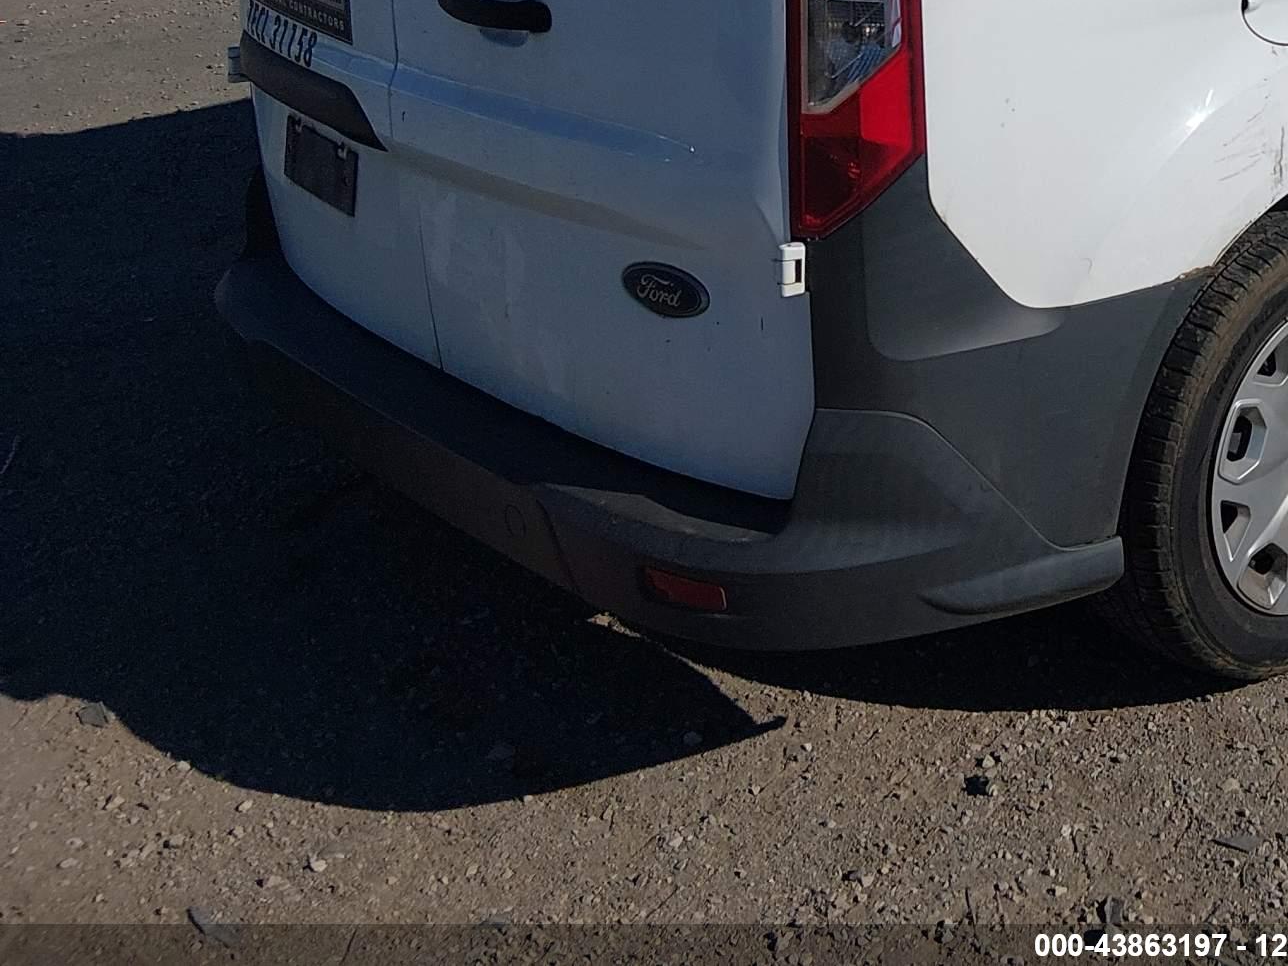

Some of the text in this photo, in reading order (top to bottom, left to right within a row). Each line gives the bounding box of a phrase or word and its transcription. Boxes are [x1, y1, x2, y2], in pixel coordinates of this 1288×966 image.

[288, 0, 345, 31] CONTRACTORS
[268, 15, 318, 68] 31158
[637, 274, 682, 307] Ford
